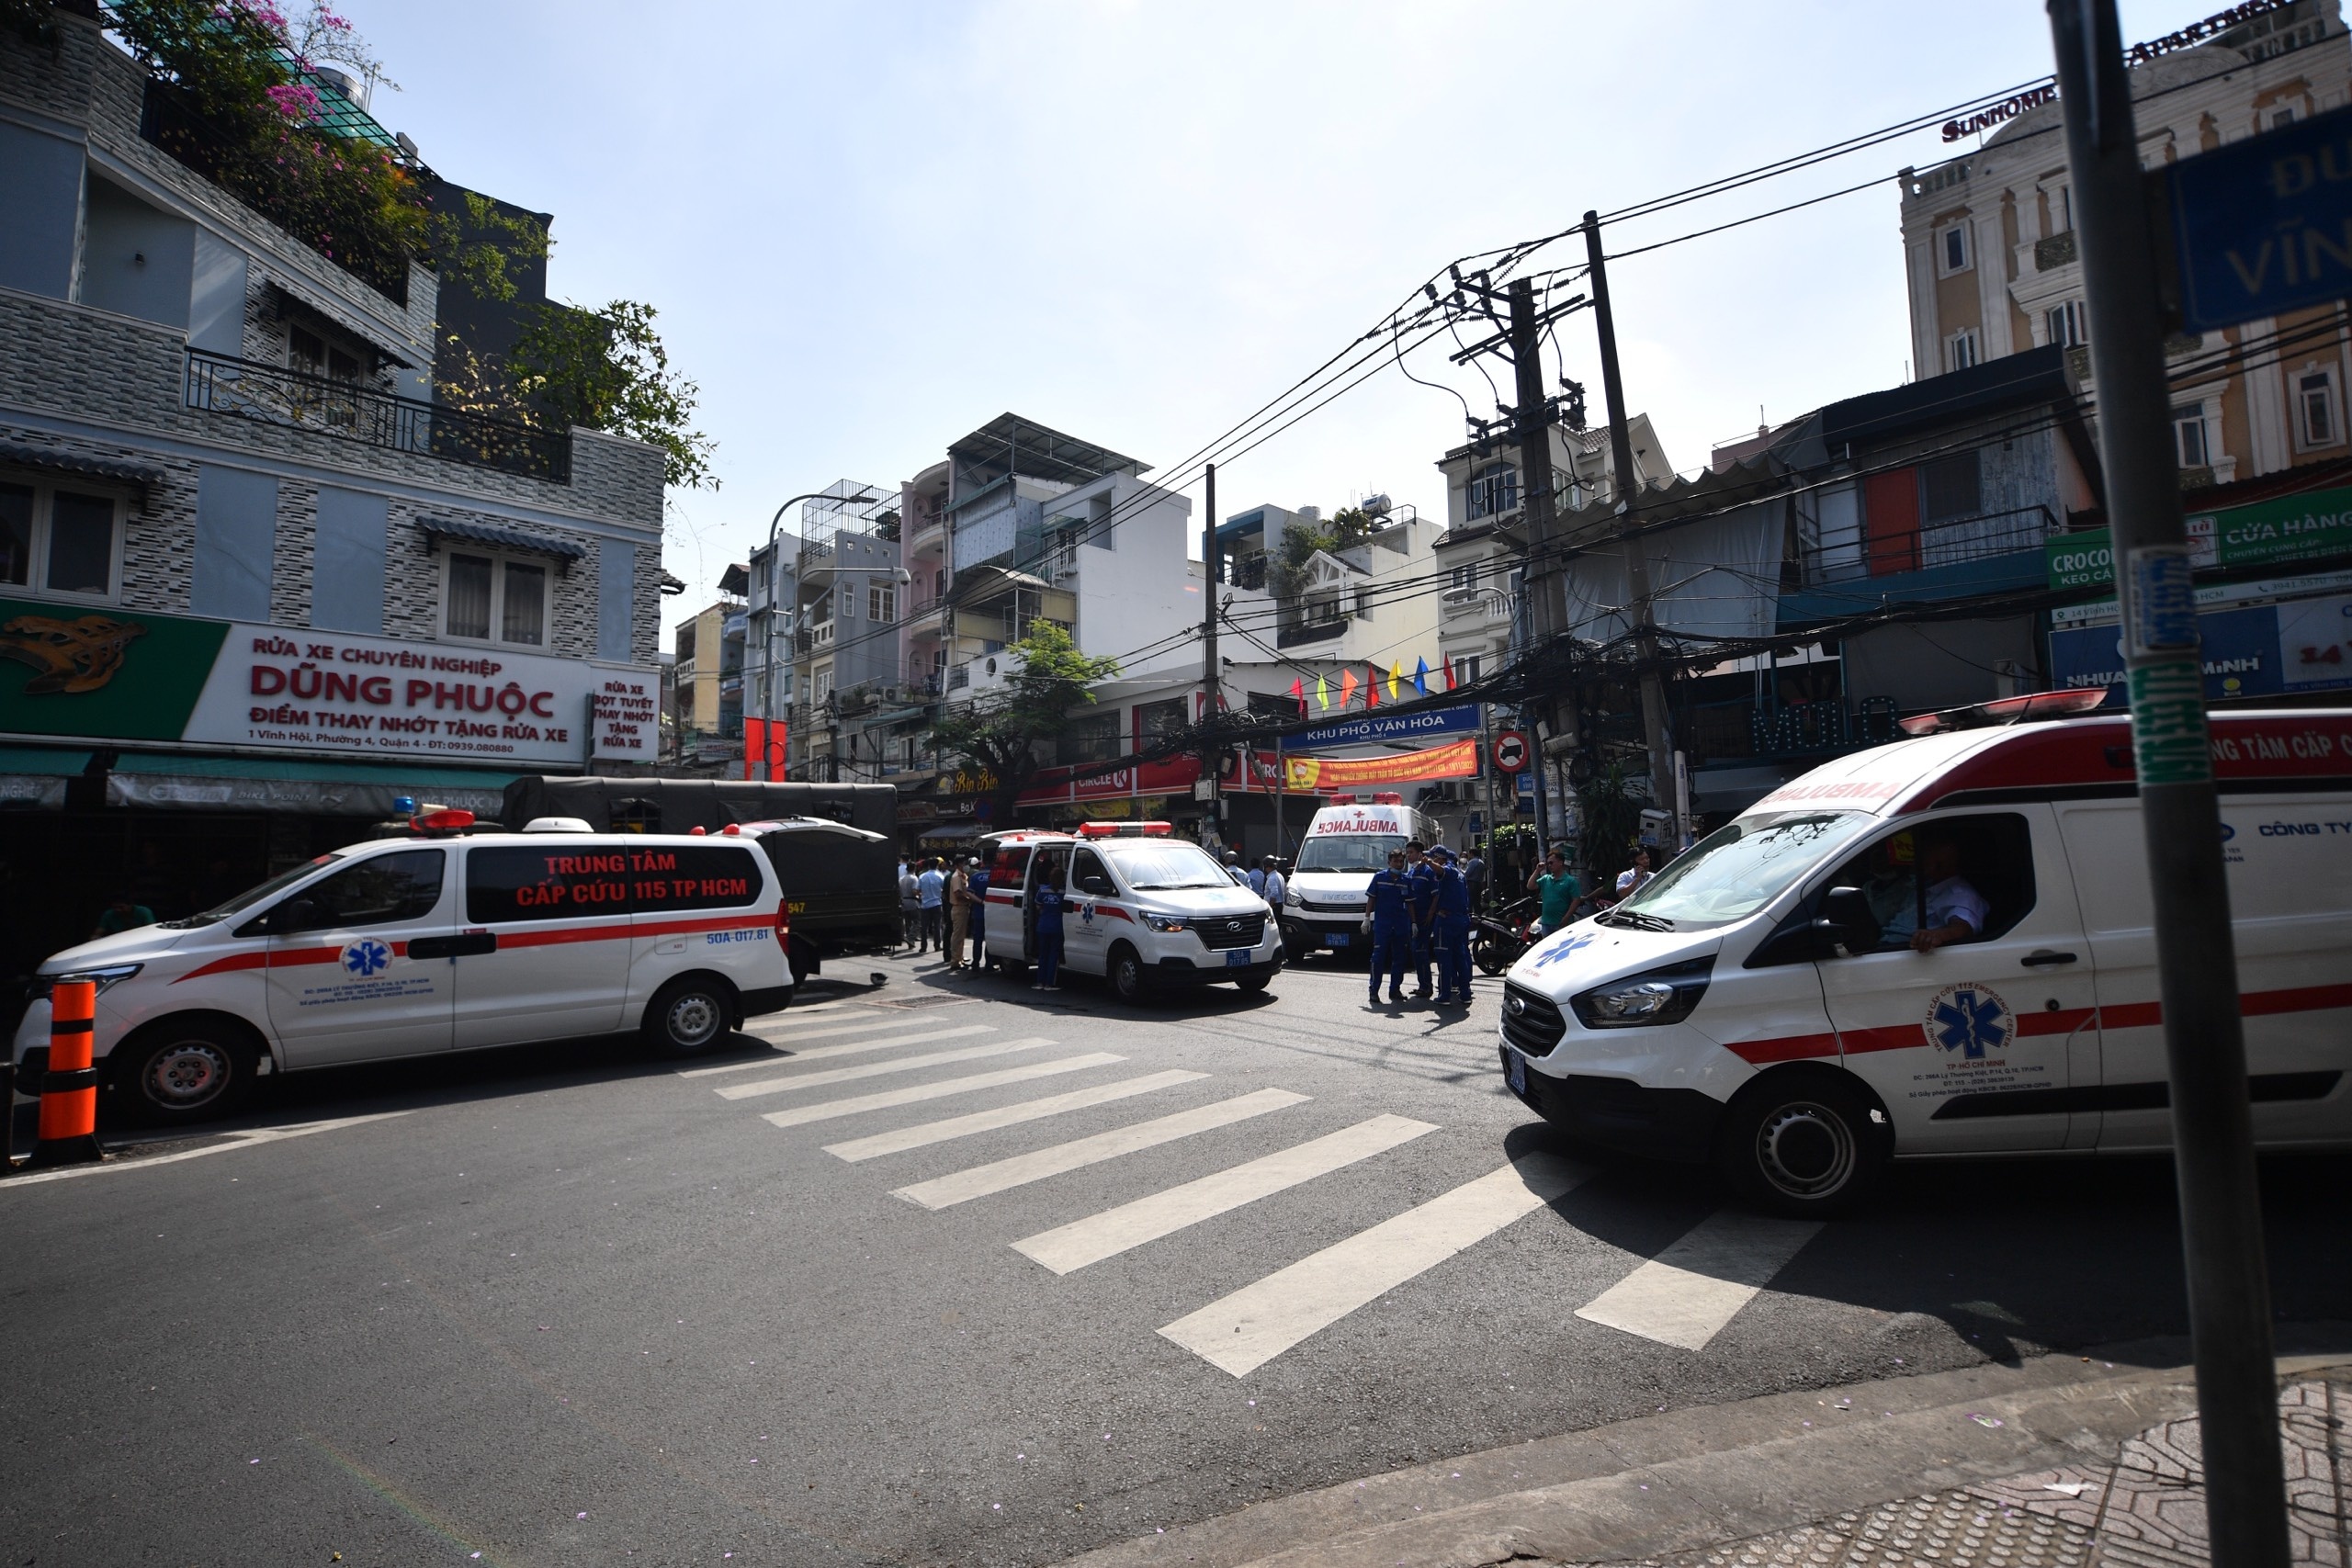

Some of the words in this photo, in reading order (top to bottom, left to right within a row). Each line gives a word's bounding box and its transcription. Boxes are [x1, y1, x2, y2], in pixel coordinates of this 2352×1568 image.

[2225, 216, 2352, 297] VĨN
[2226, 521, 2277, 546] CỬA
[2052, 547, 2116, 573] CROCO
[2061, 572, 2088, 586] KEO
[2091, 568, 2113, 581] CÁ
[2101, 603, 2120, 614] Hộ
[254, 636, 299, 657] RỬA
[306, 644, 334, 660] XE
[341, 649, 426, 669] CHUYÊN
[432, 656, 503, 678] NGHIỆP
[251, 661, 392, 705] DŨNG
[407, 680, 554, 722] PHUỘC
[605, 681, 628, 694] RỬA
[630, 685, 644, 694] XE
[594, 695, 616, 706] BỌT
[620, 697, 653, 709] TUYẾT
[249, 703, 310, 726] ĐIỂM
[315, 712, 375, 729] THAY
[380, 716, 440, 734] NHỚT
[445, 719, 497, 738] TẶNG
[503, 723, 540, 741] RỬA
[545, 728, 568, 742] XE
[594, 709, 620, 719] THAY
[624, 711, 654, 722] NHỚT
[608, 722, 638, 735] TẶNG
[1306, 728, 1337, 741] KHU
[1339, 721, 1371, 737] PHỐ
[1374, 719, 1406, 732] VĂN
[1410, 714, 1445, 728] HÓA
[249, 729, 254, 739] 1
[258, 729, 287, 740] Vĩnh
[289, 731, 313, 743] Hội,
[316, 733, 362, 747] Phường
[365, 737, 376, 747] 4,
[379, 738, 410, 749] Quận
[413, 739, 420, 748] 4
[428, 740, 447, 750] ĐT:
[447, 741, 514, 753] 0939.080880
[603, 735, 626, 747] RỬA
[628, 739, 641, 749] XE
[2241, 732, 2290, 761] TÂM
[1078, 773, 1111, 787] CIRCLE
[237, 792, 268, 800] BIKE
[272, 793, 311, 802] POINT
[2259, 820, 2320, 837] CÔNG
[2324, 822, 2352, 834] TY
[544, 856, 626, 875] TRUNG
[629, 850, 677, 873] TÂM
[516, 878, 567, 907] CẤP
[571, 879, 626, 904] CỨU
[634, 881, 667, 899] 115
[672, 879, 697, 897] TP
[701, 878, 748, 897] HCM
[1322, 893, 1356, 901] IVECO
[707, 929, 768, 944] 50A-017.81
[1958, 982, 1973, 990] 115
[1959, 1061, 1971, 1070] HỒ
[1972, 1060, 1984, 1068] CHÍ
[1986, 1059, 2006, 1067] MINH
